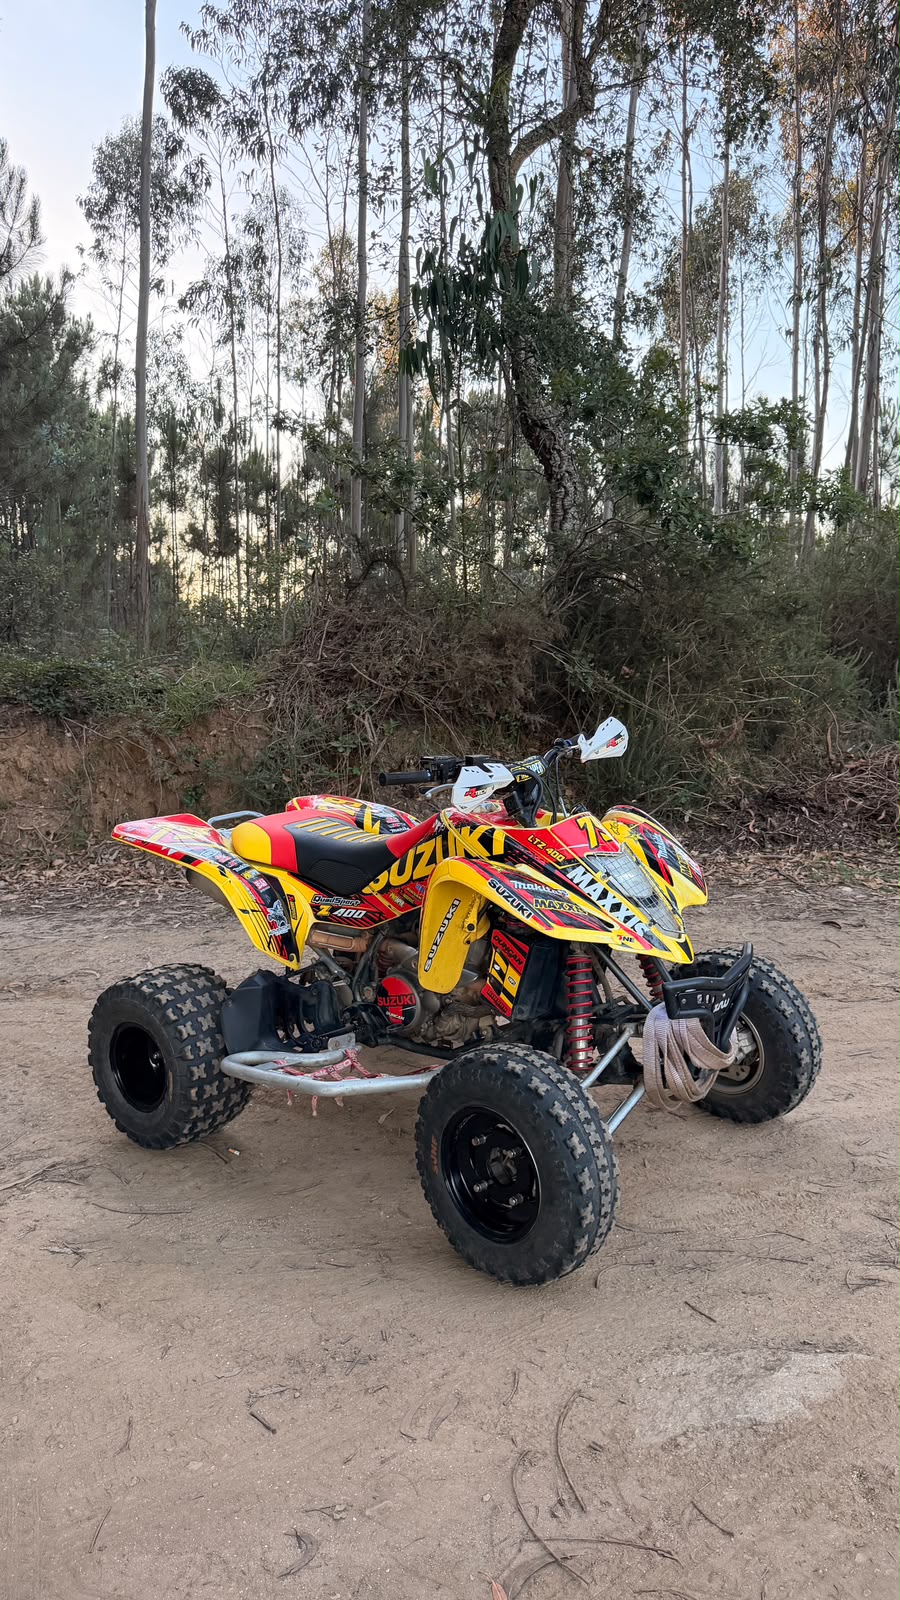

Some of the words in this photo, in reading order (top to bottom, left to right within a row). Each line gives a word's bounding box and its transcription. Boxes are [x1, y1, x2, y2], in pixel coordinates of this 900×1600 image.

[527, 834, 547, 850] LTZ
[545, 847, 566, 863] 400
[311, 894, 361, 906] QuadSport
[316, 905, 332, 917] Z
[332, 908, 367, 919] 400
[487, 878, 534, 920] SUZUKI
[566, 865, 650, 937] MAXXIS
[423, 898, 462, 973] SUZUKI
[493, 935, 524, 966] DUNCAN
[377, 995, 416, 1007] SUZUKI
